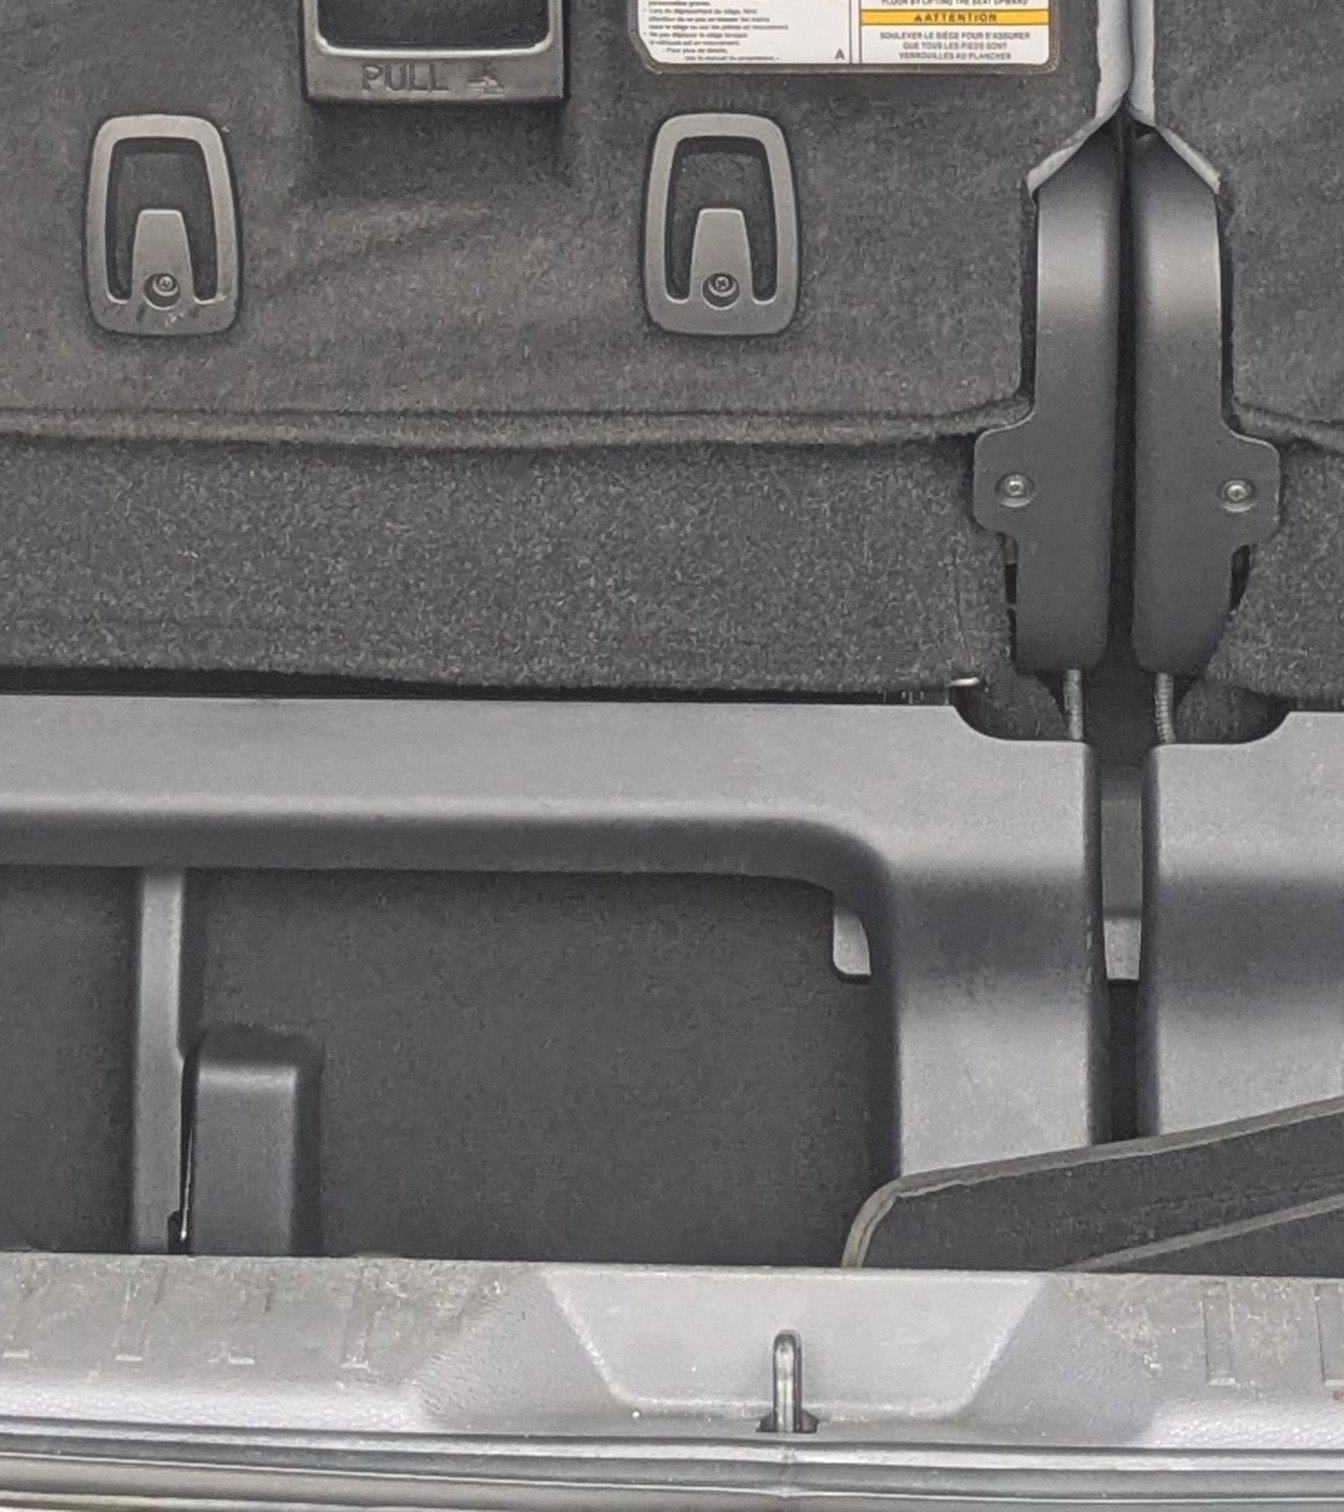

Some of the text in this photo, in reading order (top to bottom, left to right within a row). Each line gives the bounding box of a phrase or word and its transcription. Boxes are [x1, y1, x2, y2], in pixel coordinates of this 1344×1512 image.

[923, 13, 998, 22] ATTENTION
[834, 48, 846, 61] A
[360, 61, 450, 93] PULL
